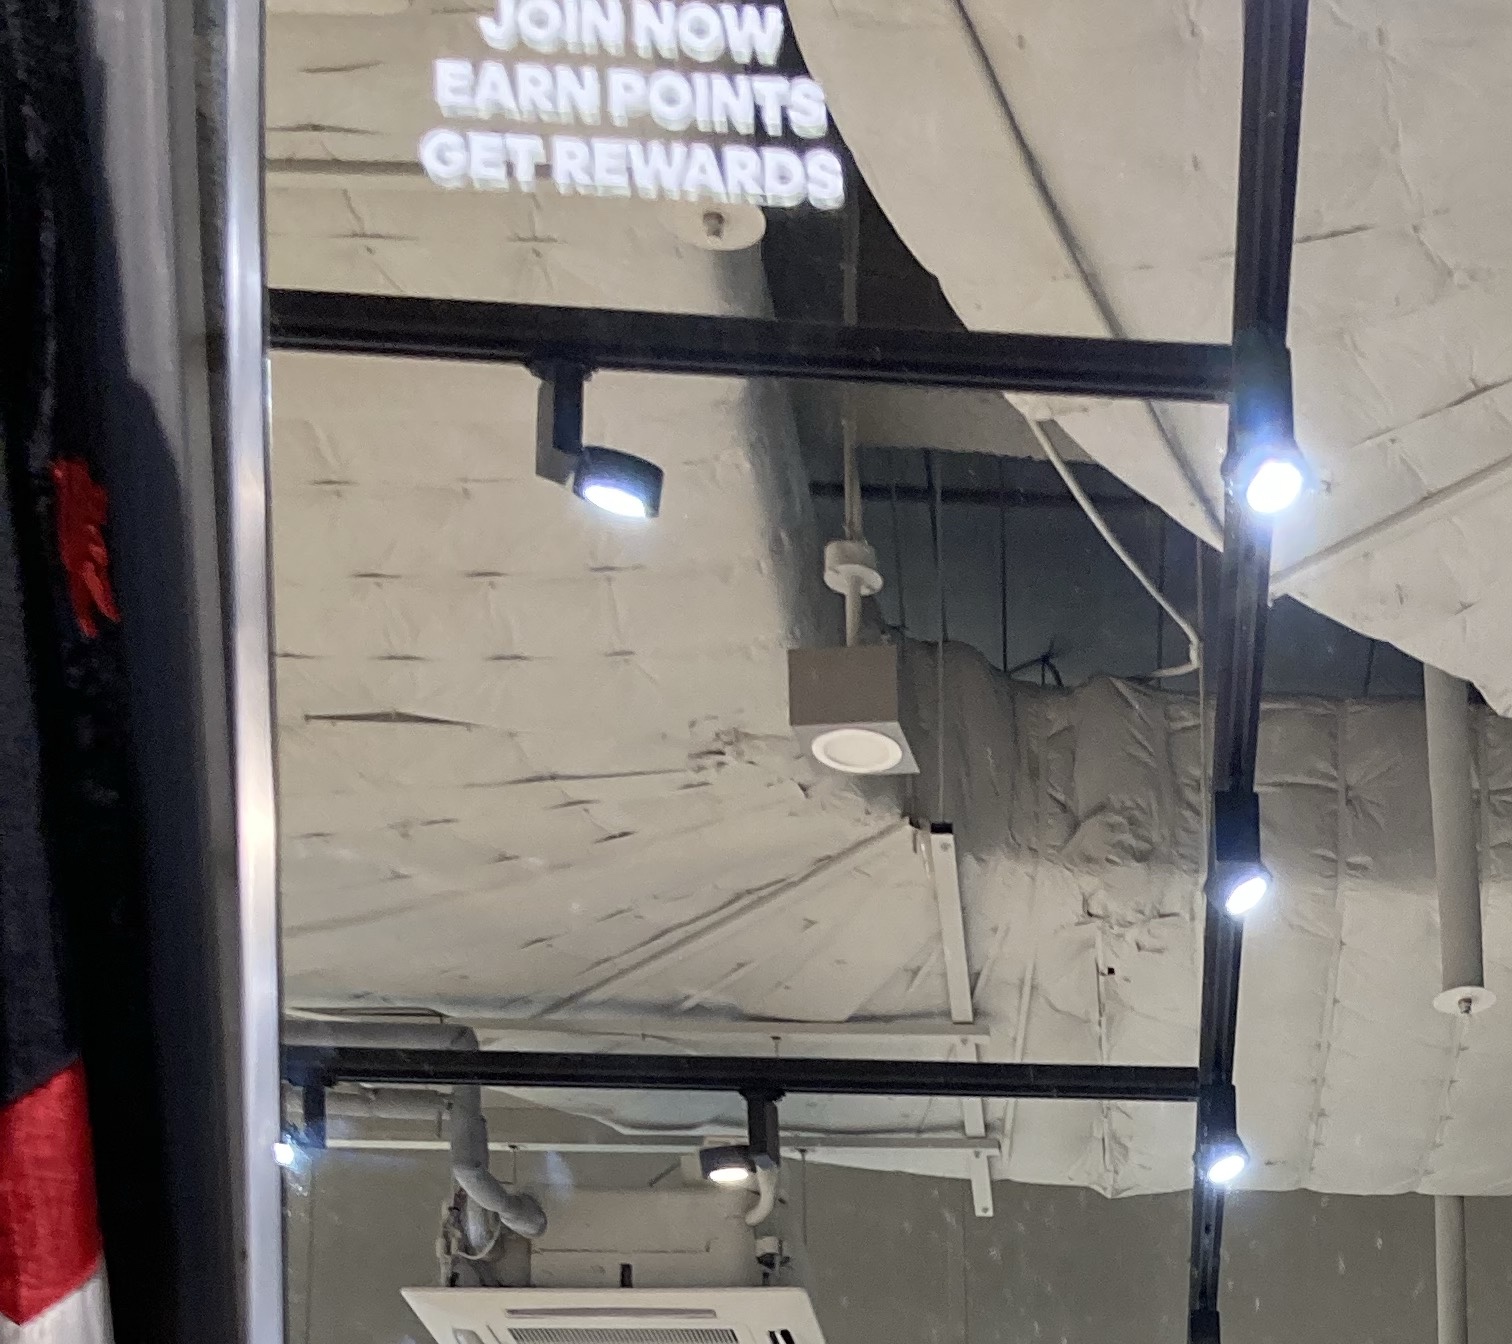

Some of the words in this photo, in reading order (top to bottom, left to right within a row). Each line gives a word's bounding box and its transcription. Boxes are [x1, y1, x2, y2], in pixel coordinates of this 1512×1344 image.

[477, 0, 622, 55] JOIN
[632, 2, 785, 67] NOW
[432, 58, 601, 126] EARN
[608, 70, 829, 138] POINTS
[419, 128, 545, 191] GET
[552, 138, 846, 210] REWARDS
